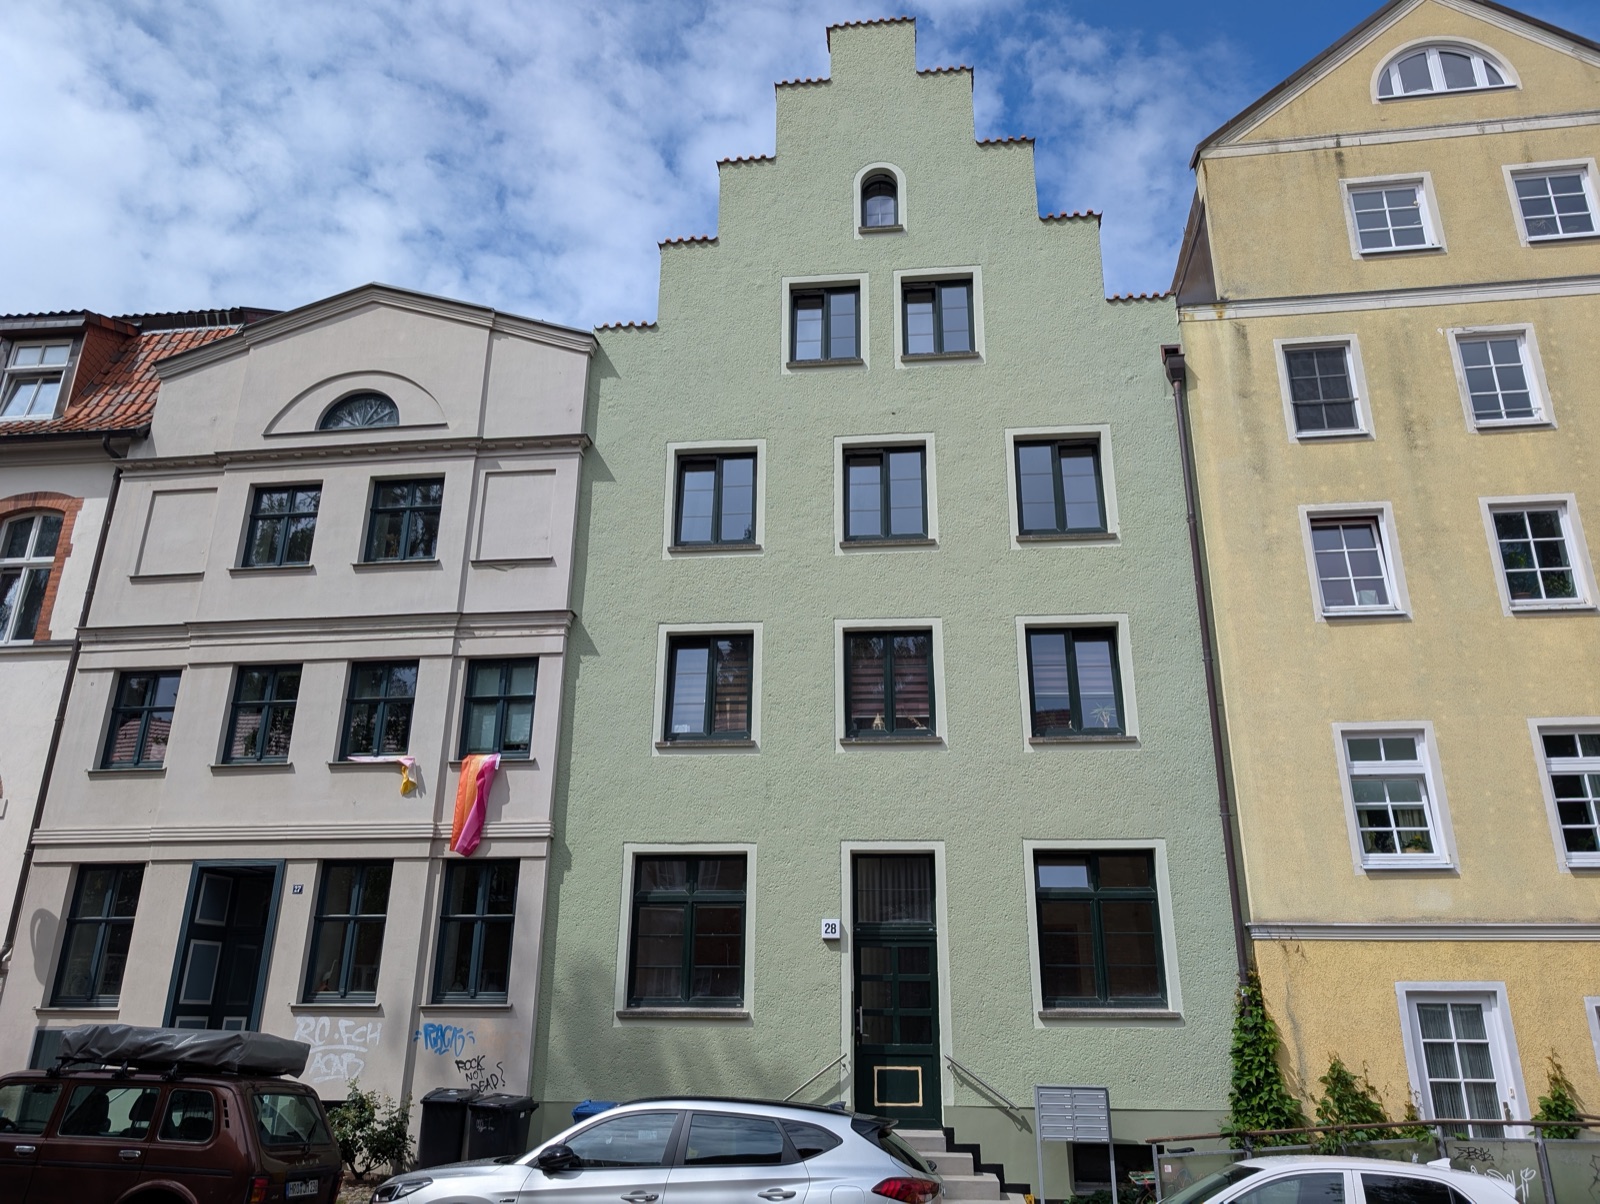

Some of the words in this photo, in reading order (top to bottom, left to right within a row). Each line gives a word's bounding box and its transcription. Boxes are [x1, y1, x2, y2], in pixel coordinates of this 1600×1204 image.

[824, 922, 837, 935] 28
[455, 1055, 486, 1073] ROCK
[465, 1069, 484, 1082] NOT
